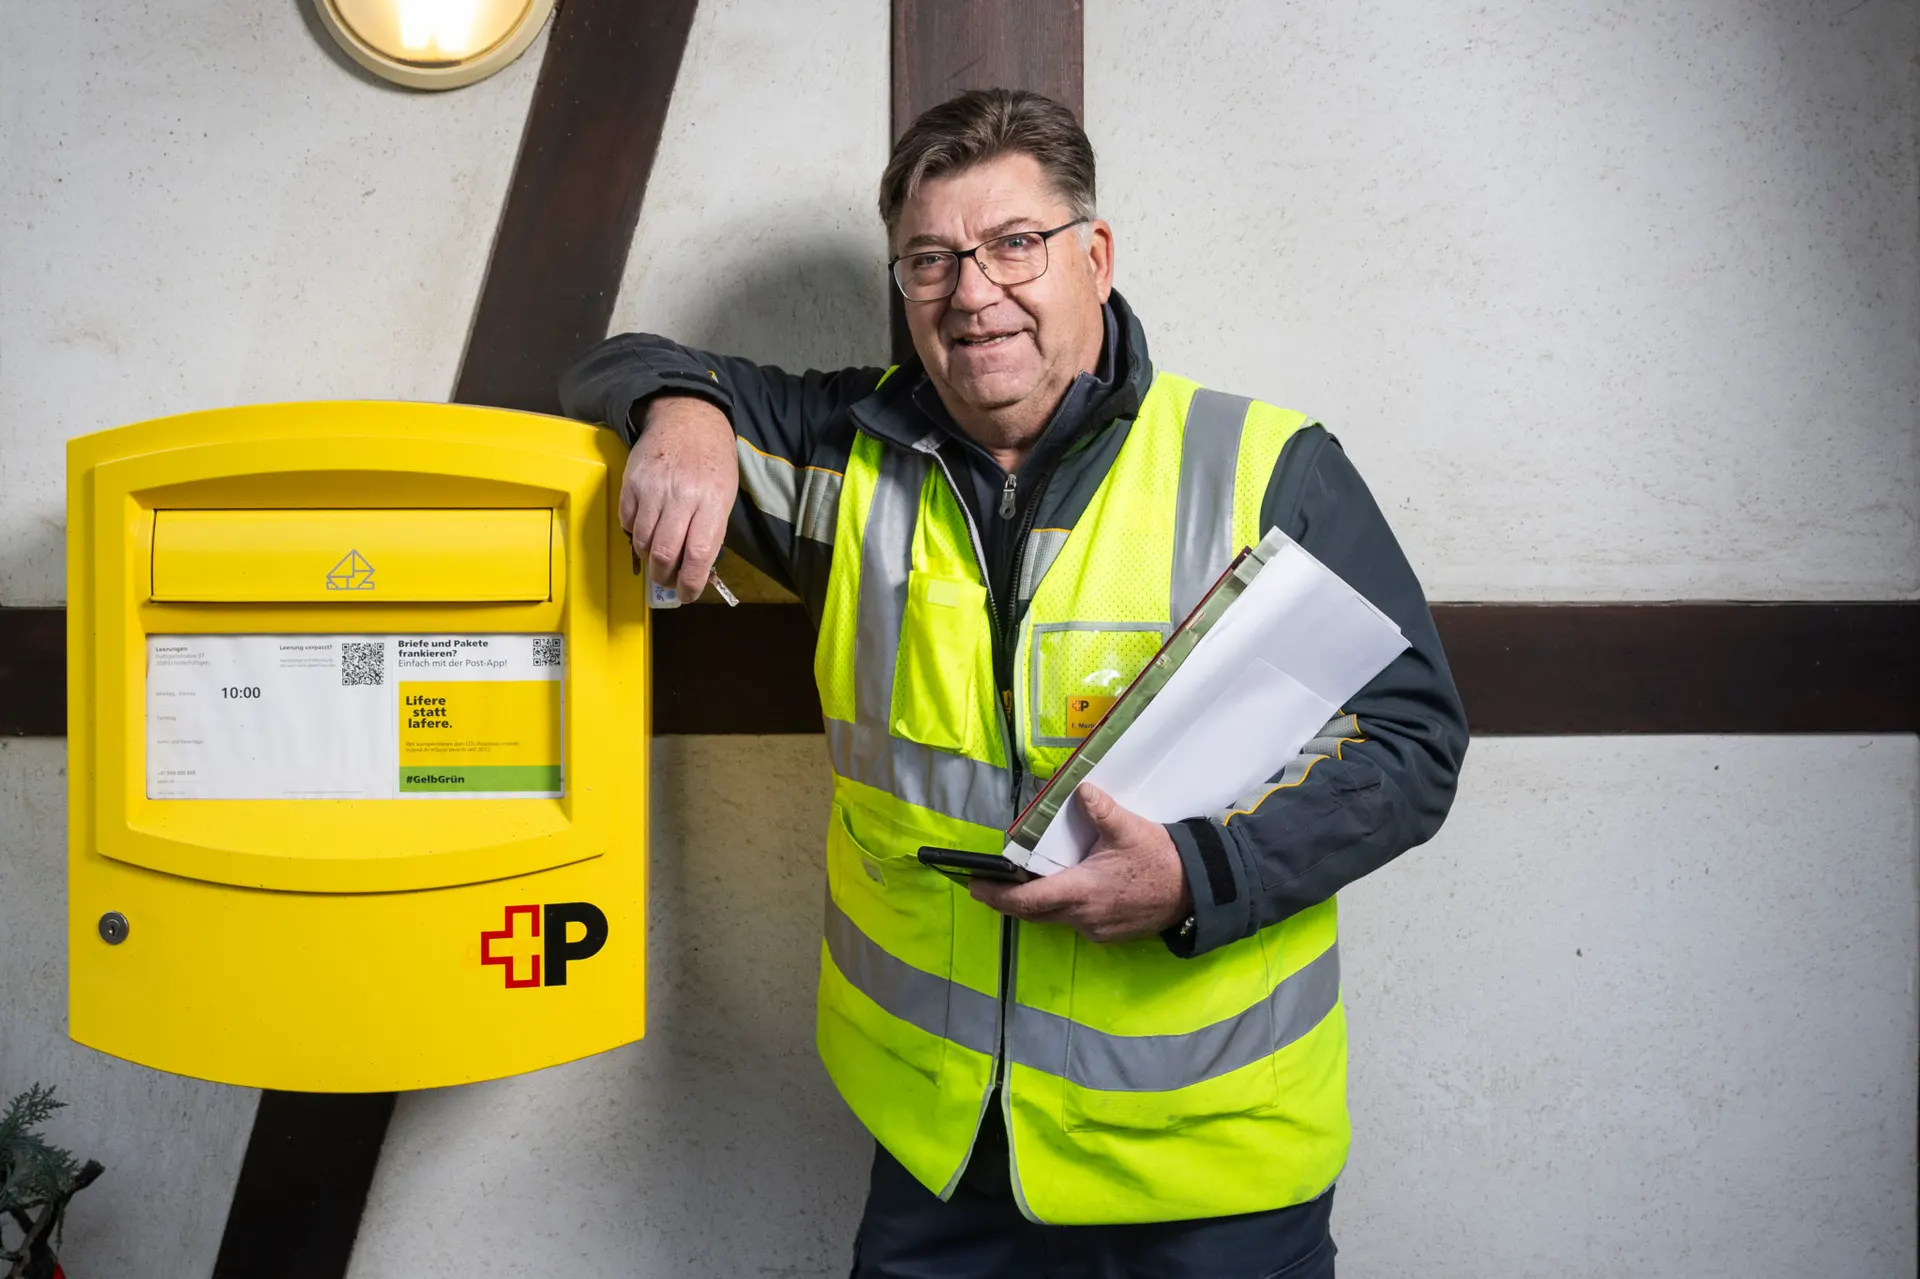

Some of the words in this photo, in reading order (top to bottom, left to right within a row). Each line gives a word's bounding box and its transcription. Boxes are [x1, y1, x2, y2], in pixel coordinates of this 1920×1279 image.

[398, 640, 429, 648] Briefe
[431, 640, 451, 648] und
[454, 640, 489, 648] Pakete
[398, 649, 457, 657] frankieren?
[398, 659, 429, 667] Einfach
[432, 659, 446, 667] mit
[448, 659, 463, 667] der
[466, 659, 508, 669] Post-App!
[221, 687, 261, 699] 10:00
[406, 696, 446, 706] Lifere
[413, 707, 446, 717] statt
[408, 718, 453, 728] lafere.
[406, 775, 465, 784] #GelbGrün
[544, 902, 608, 987] P
